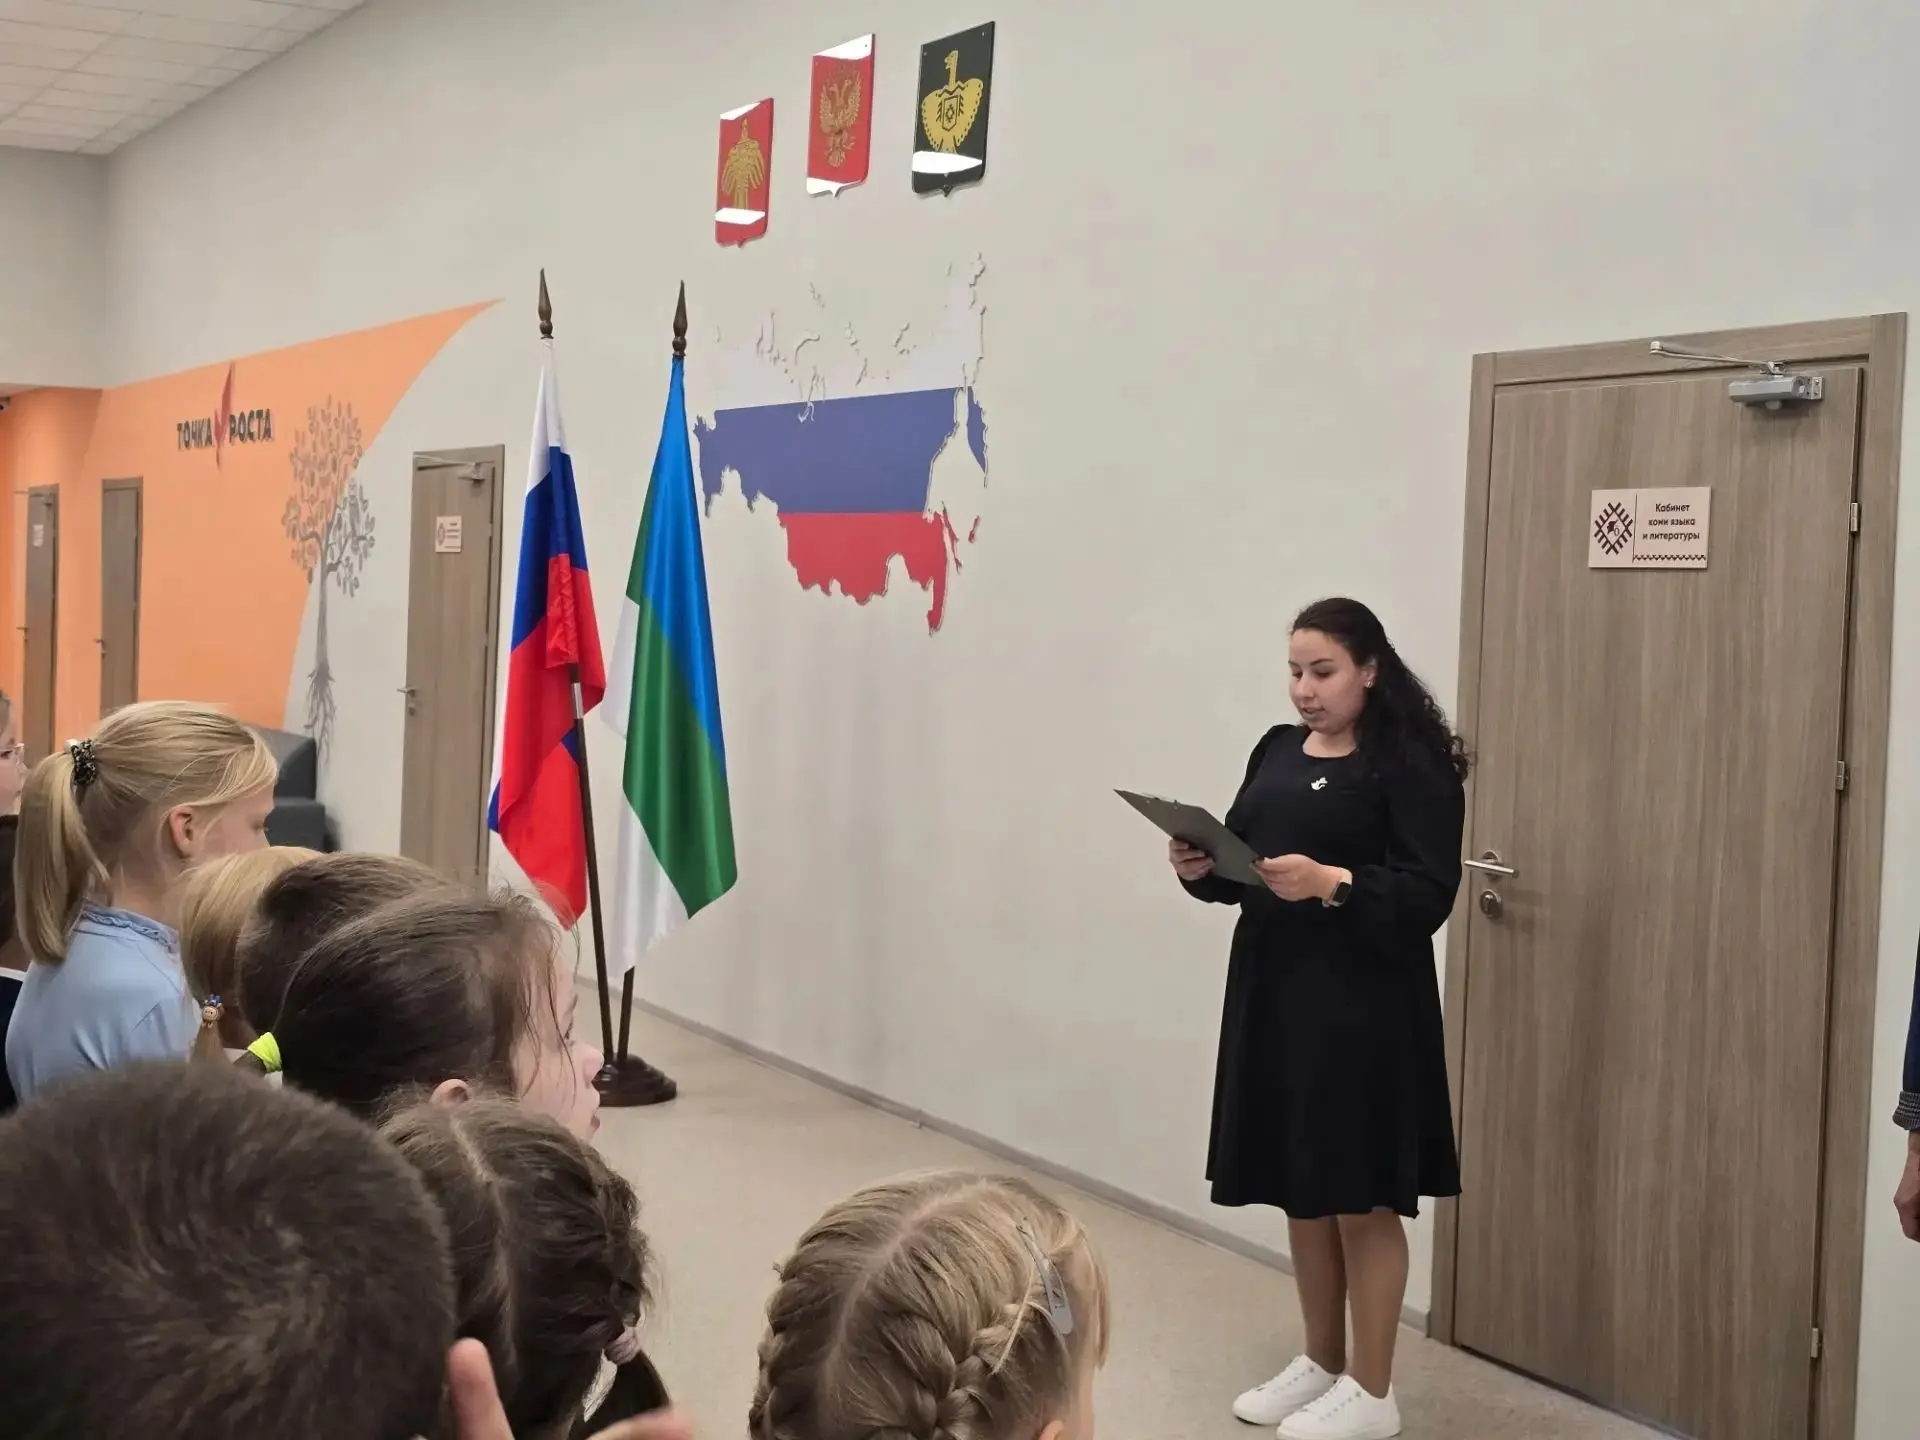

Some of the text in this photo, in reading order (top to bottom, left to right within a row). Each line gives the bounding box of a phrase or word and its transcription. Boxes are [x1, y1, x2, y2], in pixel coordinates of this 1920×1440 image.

[177, 408, 273, 450] ТОЧКА РОСТА
[1656, 503, 1690, 512] Кабинет
[1648, 518, 1696, 526] коми языка
[1649, 532, 1700, 541] литературы
